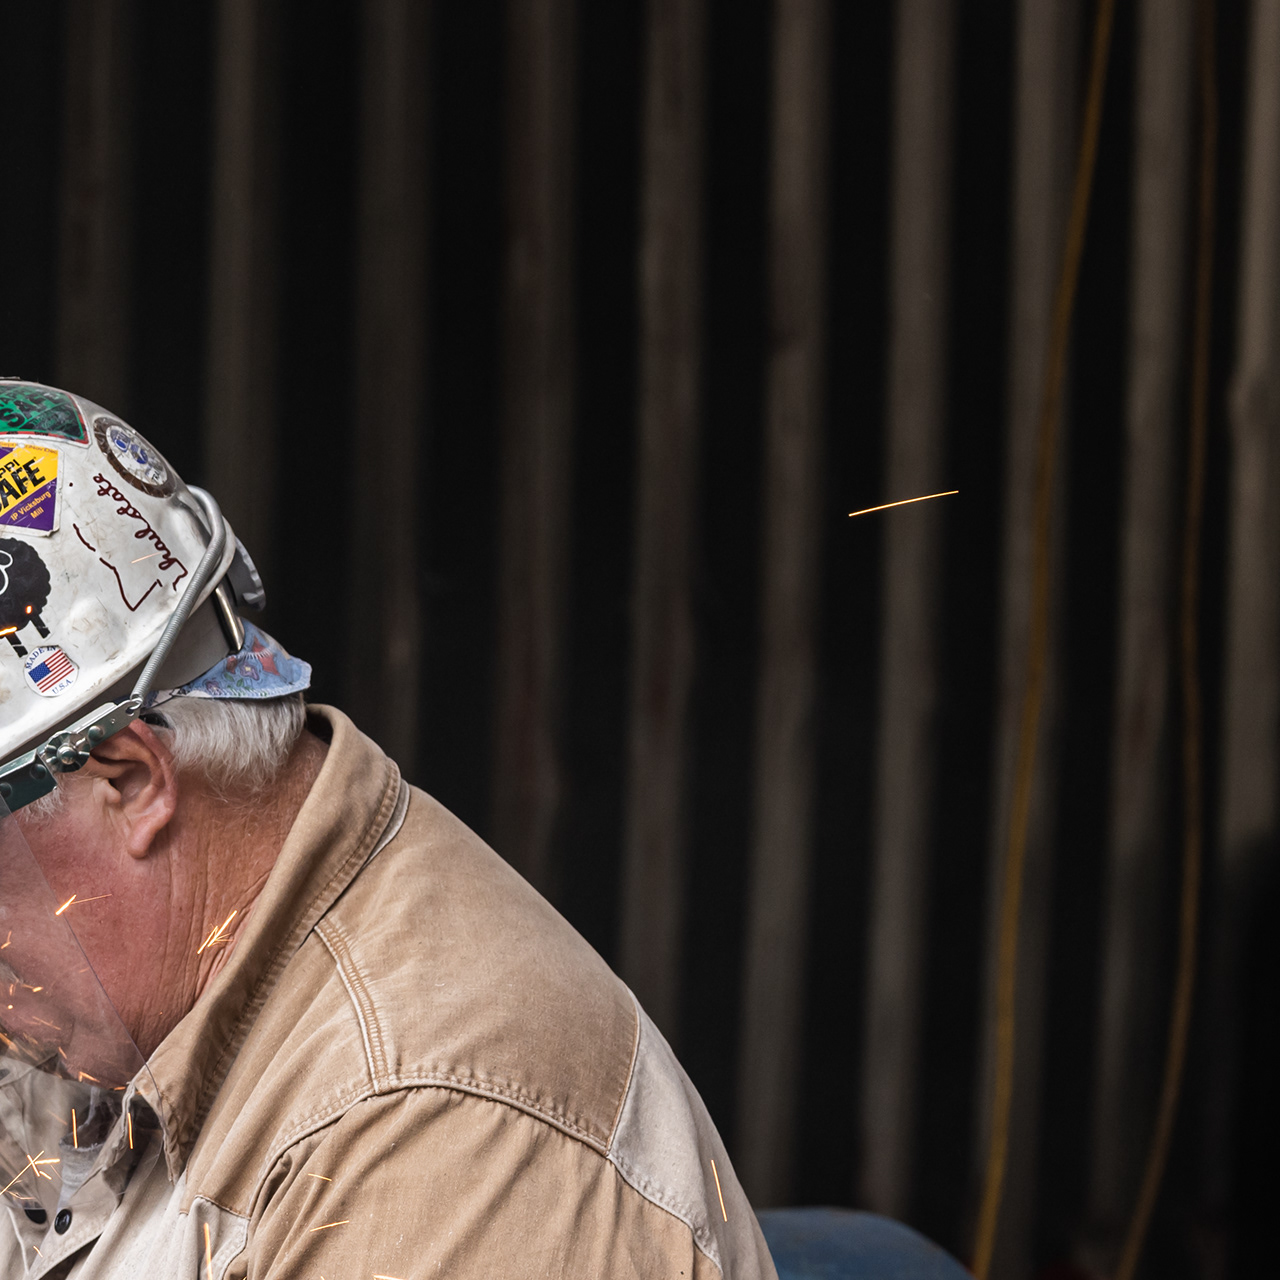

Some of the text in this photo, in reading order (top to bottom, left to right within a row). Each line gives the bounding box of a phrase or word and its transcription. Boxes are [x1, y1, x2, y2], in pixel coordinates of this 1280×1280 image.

[10, 490, 52, 521] IP Vicksburg
[30, 506, 45, 519] Mill
[25, 647, 45, 670] MADE
